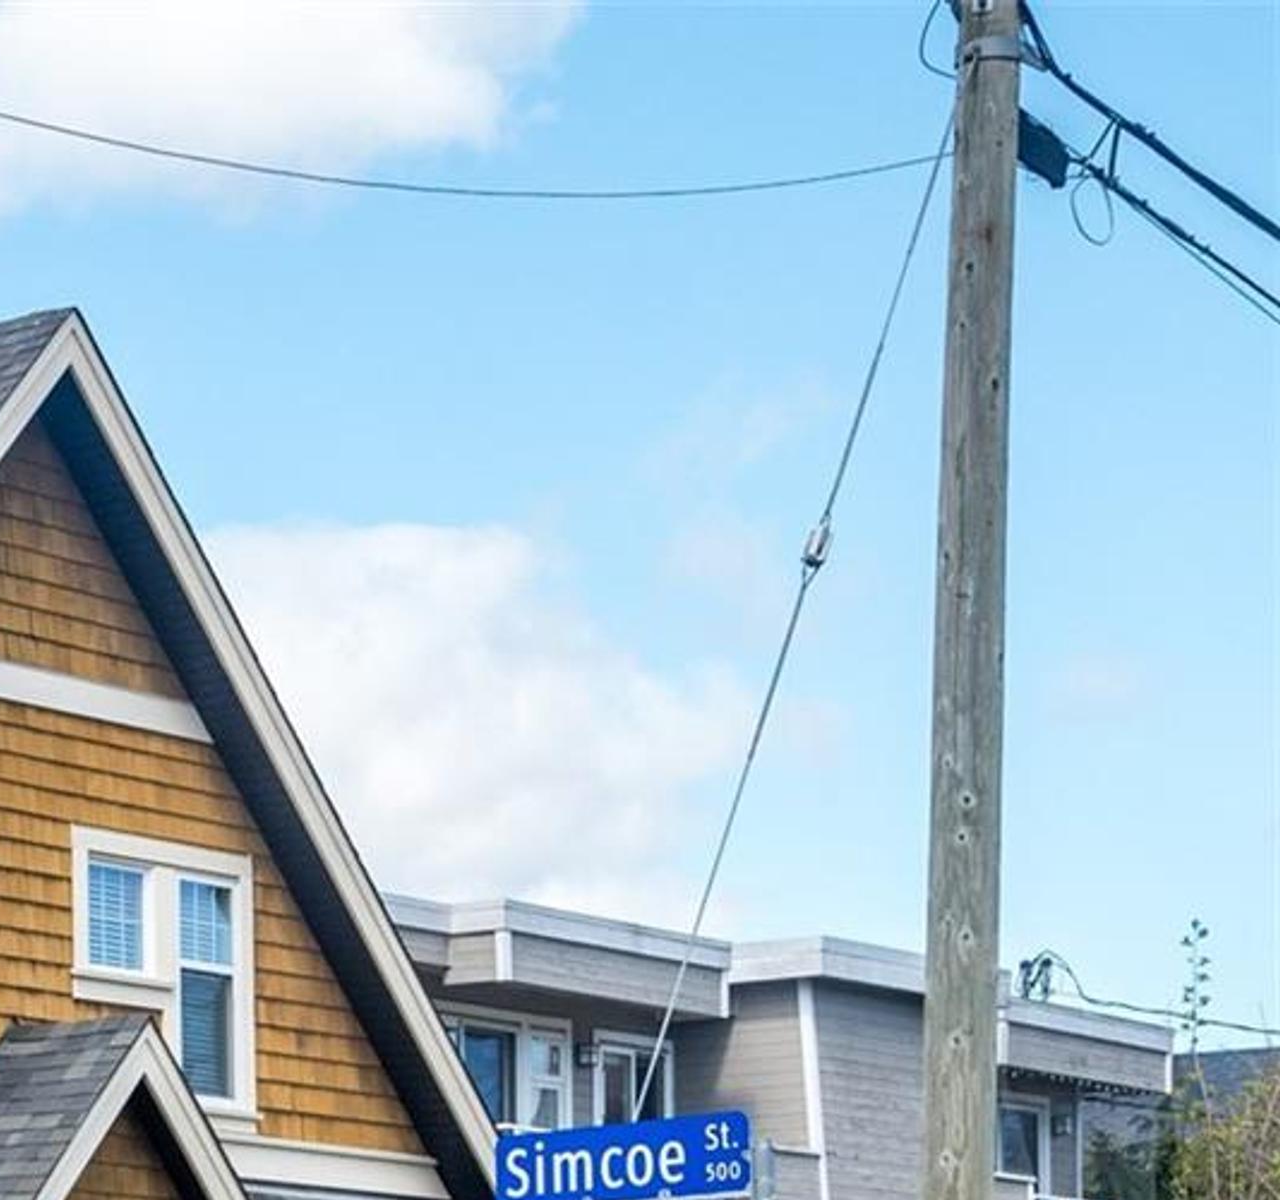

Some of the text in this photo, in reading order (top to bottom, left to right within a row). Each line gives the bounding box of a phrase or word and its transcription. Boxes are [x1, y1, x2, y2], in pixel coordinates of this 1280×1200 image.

[505, 1121, 739, 1199] Simcoe St.
[705, 1160, 741, 1182] 500
